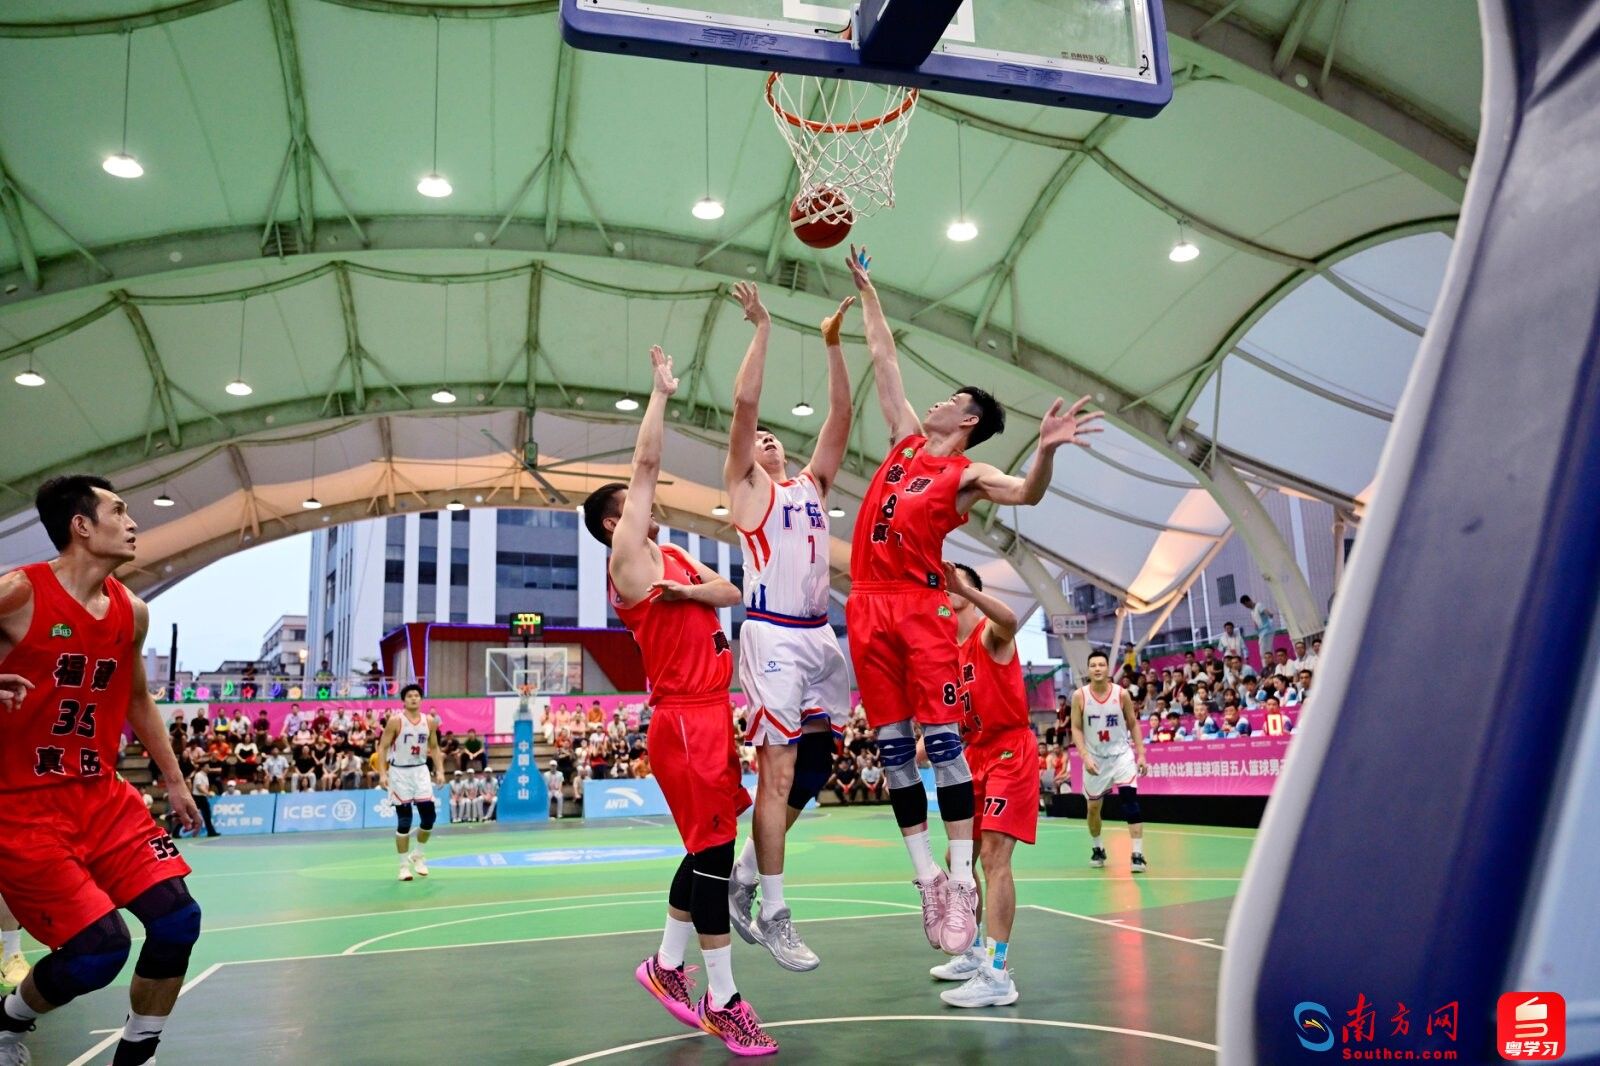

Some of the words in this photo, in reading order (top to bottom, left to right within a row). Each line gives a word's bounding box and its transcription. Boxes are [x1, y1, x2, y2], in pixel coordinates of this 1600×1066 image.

[783, 502, 827, 530] 广东
[881, 493, 898, 520] 8
[53, 653, 118, 693] 福建
[943, 682, 957, 705] 8
[52, 699, 97, 739] 35
[1088, 714, 1119, 728] 广东
[404, 733, 428, 744] 广东
[1097, 730, 1110, 742] 14
[283, 804, 326, 820] ICBC
[605, 799, 629, 809] ANTA
[148, 833, 181, 862] 35
